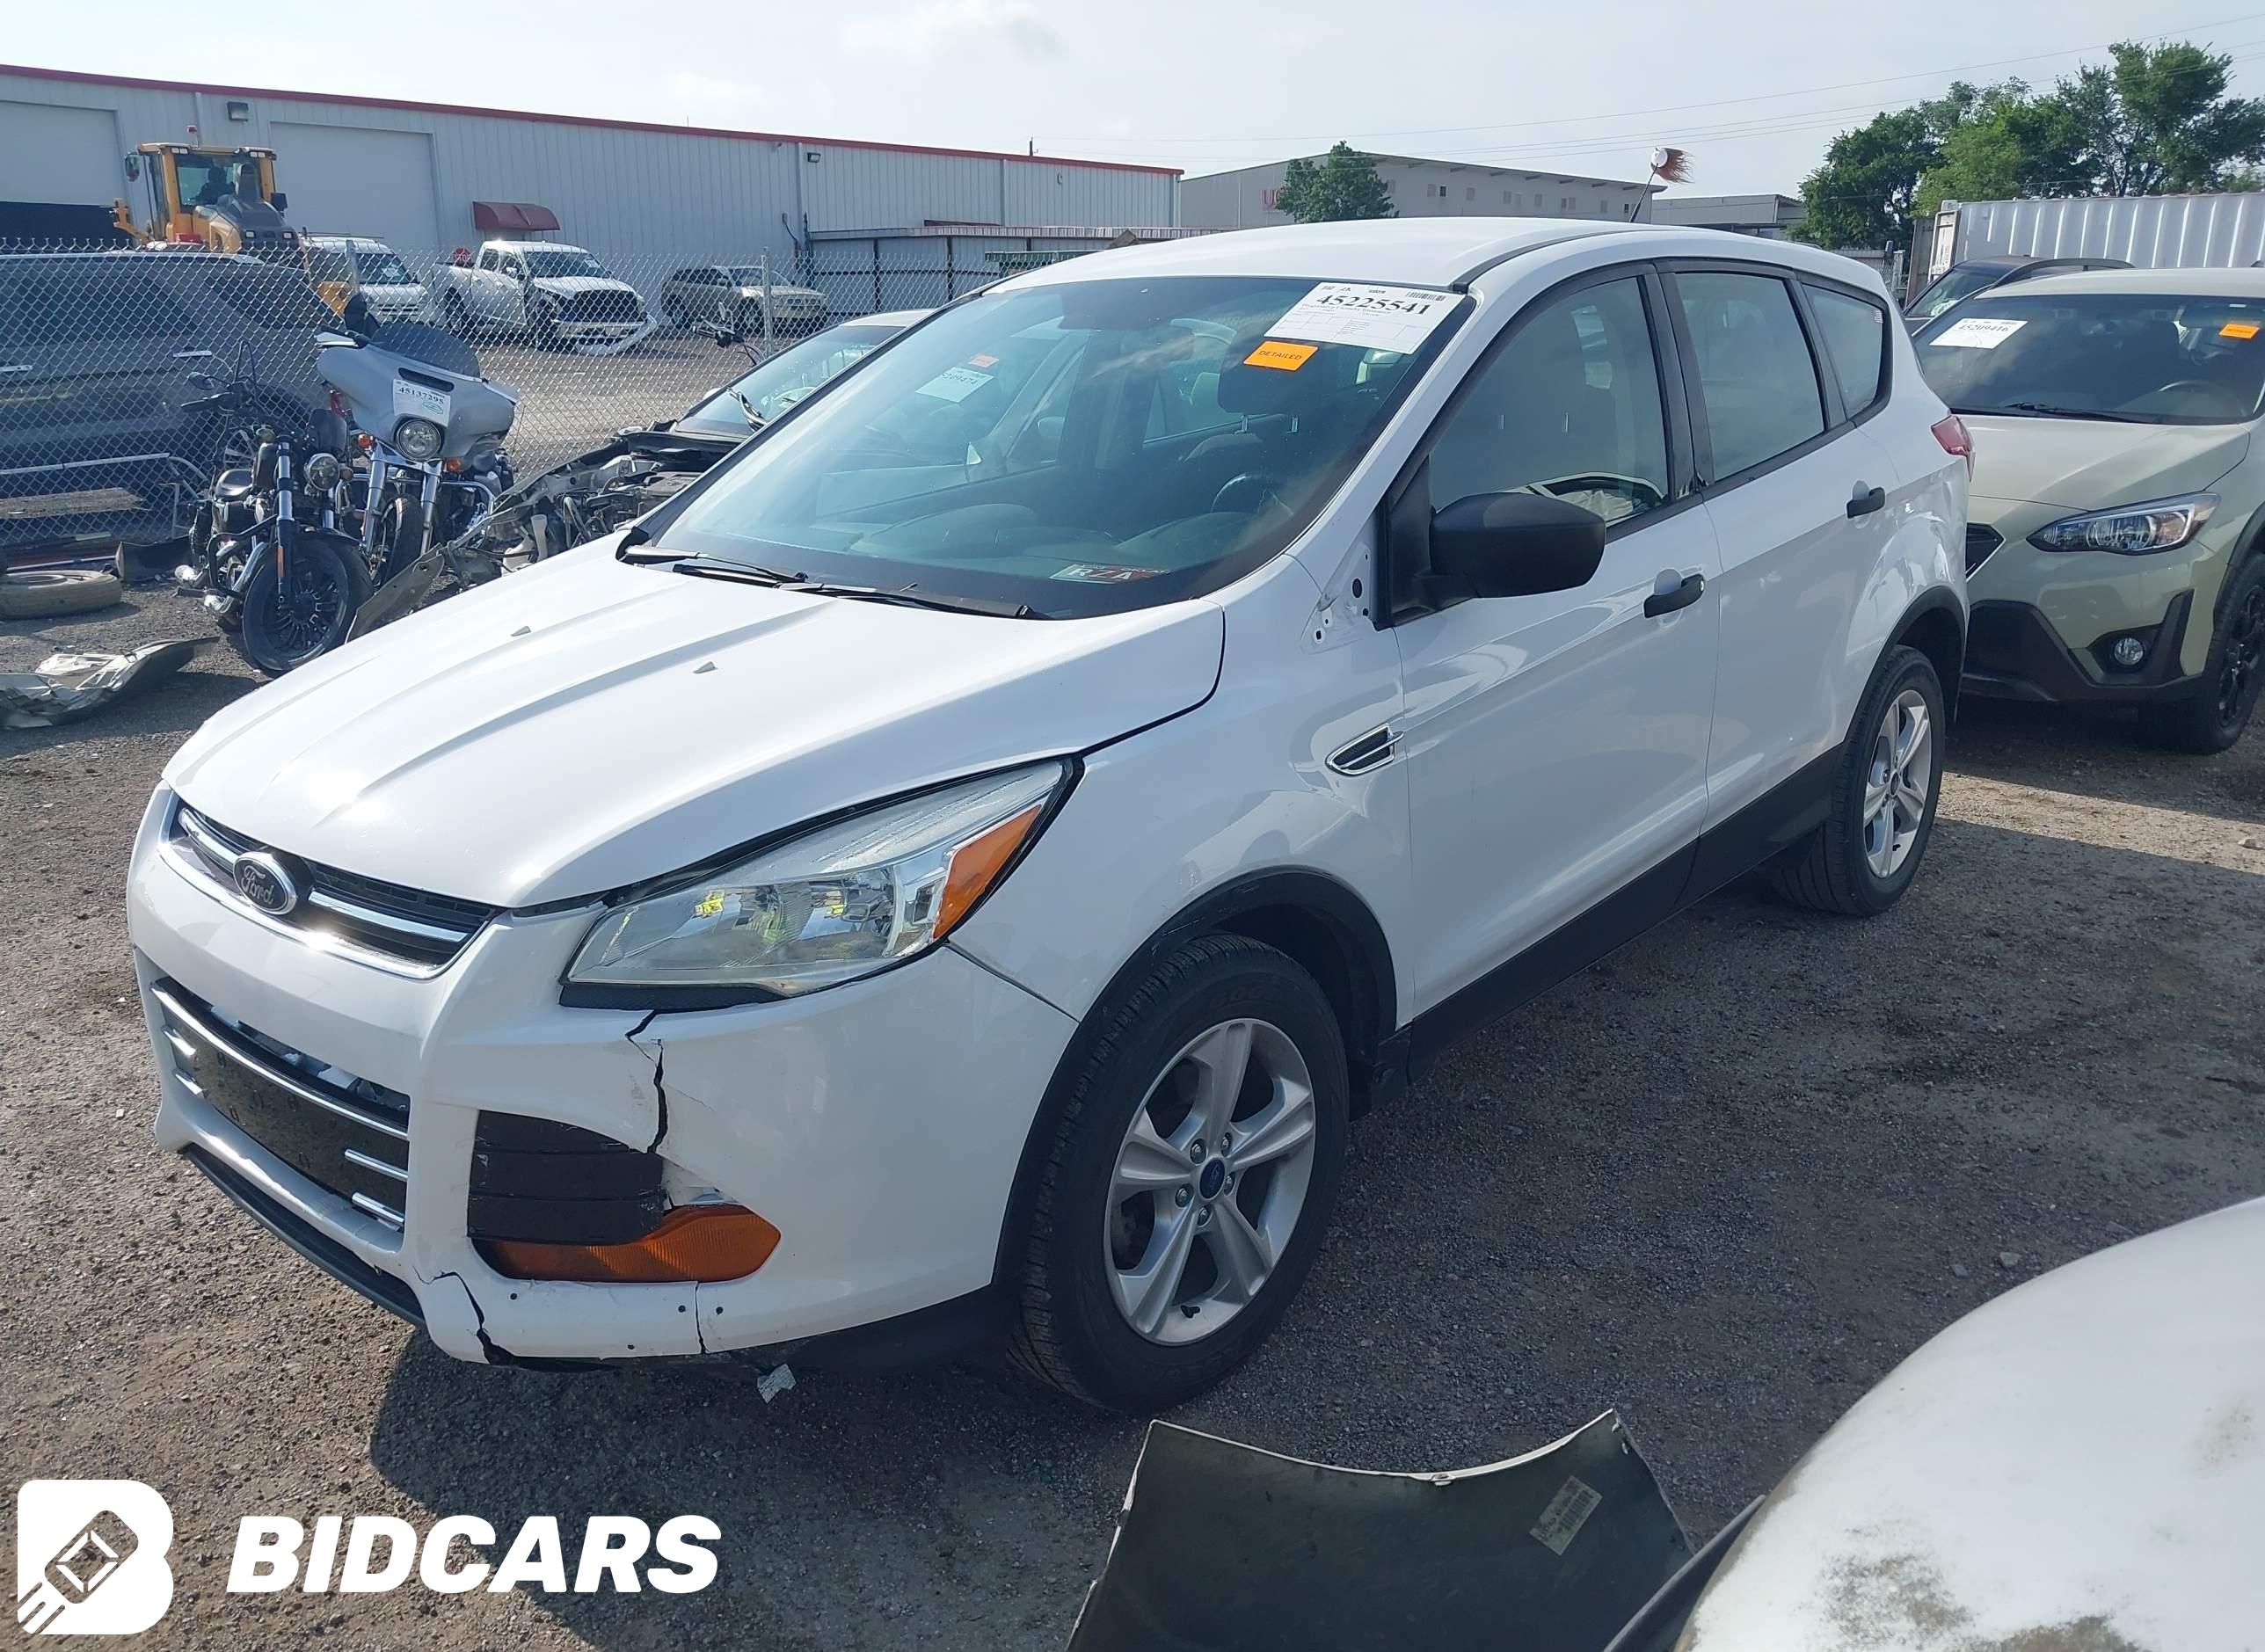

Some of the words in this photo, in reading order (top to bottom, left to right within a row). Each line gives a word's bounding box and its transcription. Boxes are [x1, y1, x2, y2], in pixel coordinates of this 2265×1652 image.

[1316, 295, 1431, 315] 45225541
[1258, 350, 1302, 360] DETAILED
[398, 387, 445, 404] 45137295
[241, 865, 275, 905] Ford
